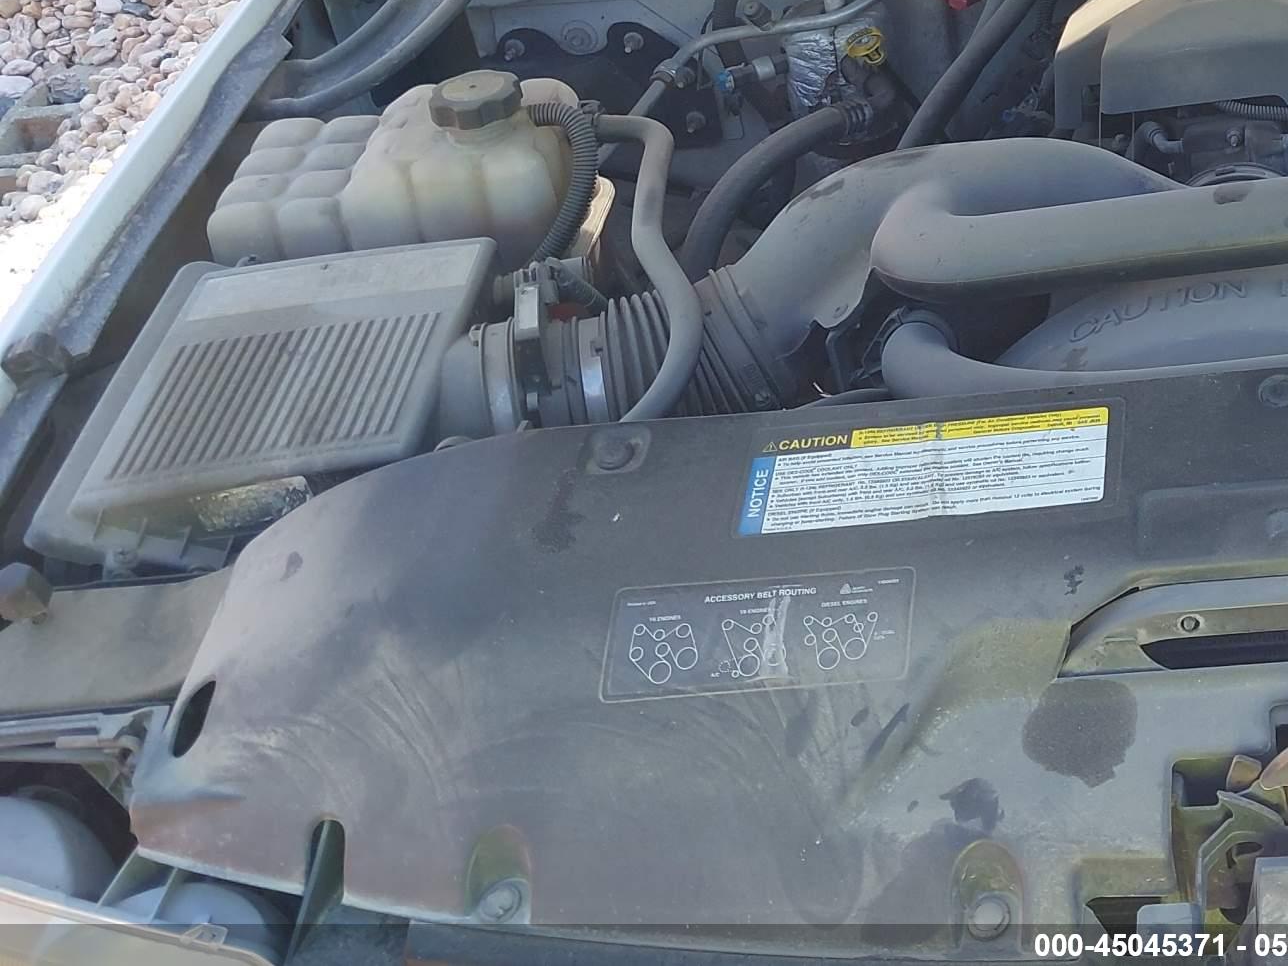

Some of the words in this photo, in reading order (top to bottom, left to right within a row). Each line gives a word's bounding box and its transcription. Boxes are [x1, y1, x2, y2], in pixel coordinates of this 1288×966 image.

[1068, 279, 1248, 343] CAUTION
[779, 434, 848, 451] CAUTION
[748, 469, 770, 520] NOTICE
[704, 592, 755, 603] ACCESSORY
[756, 590, 777, 599] BELT
[778, 586, 816, 596] ROUTING
